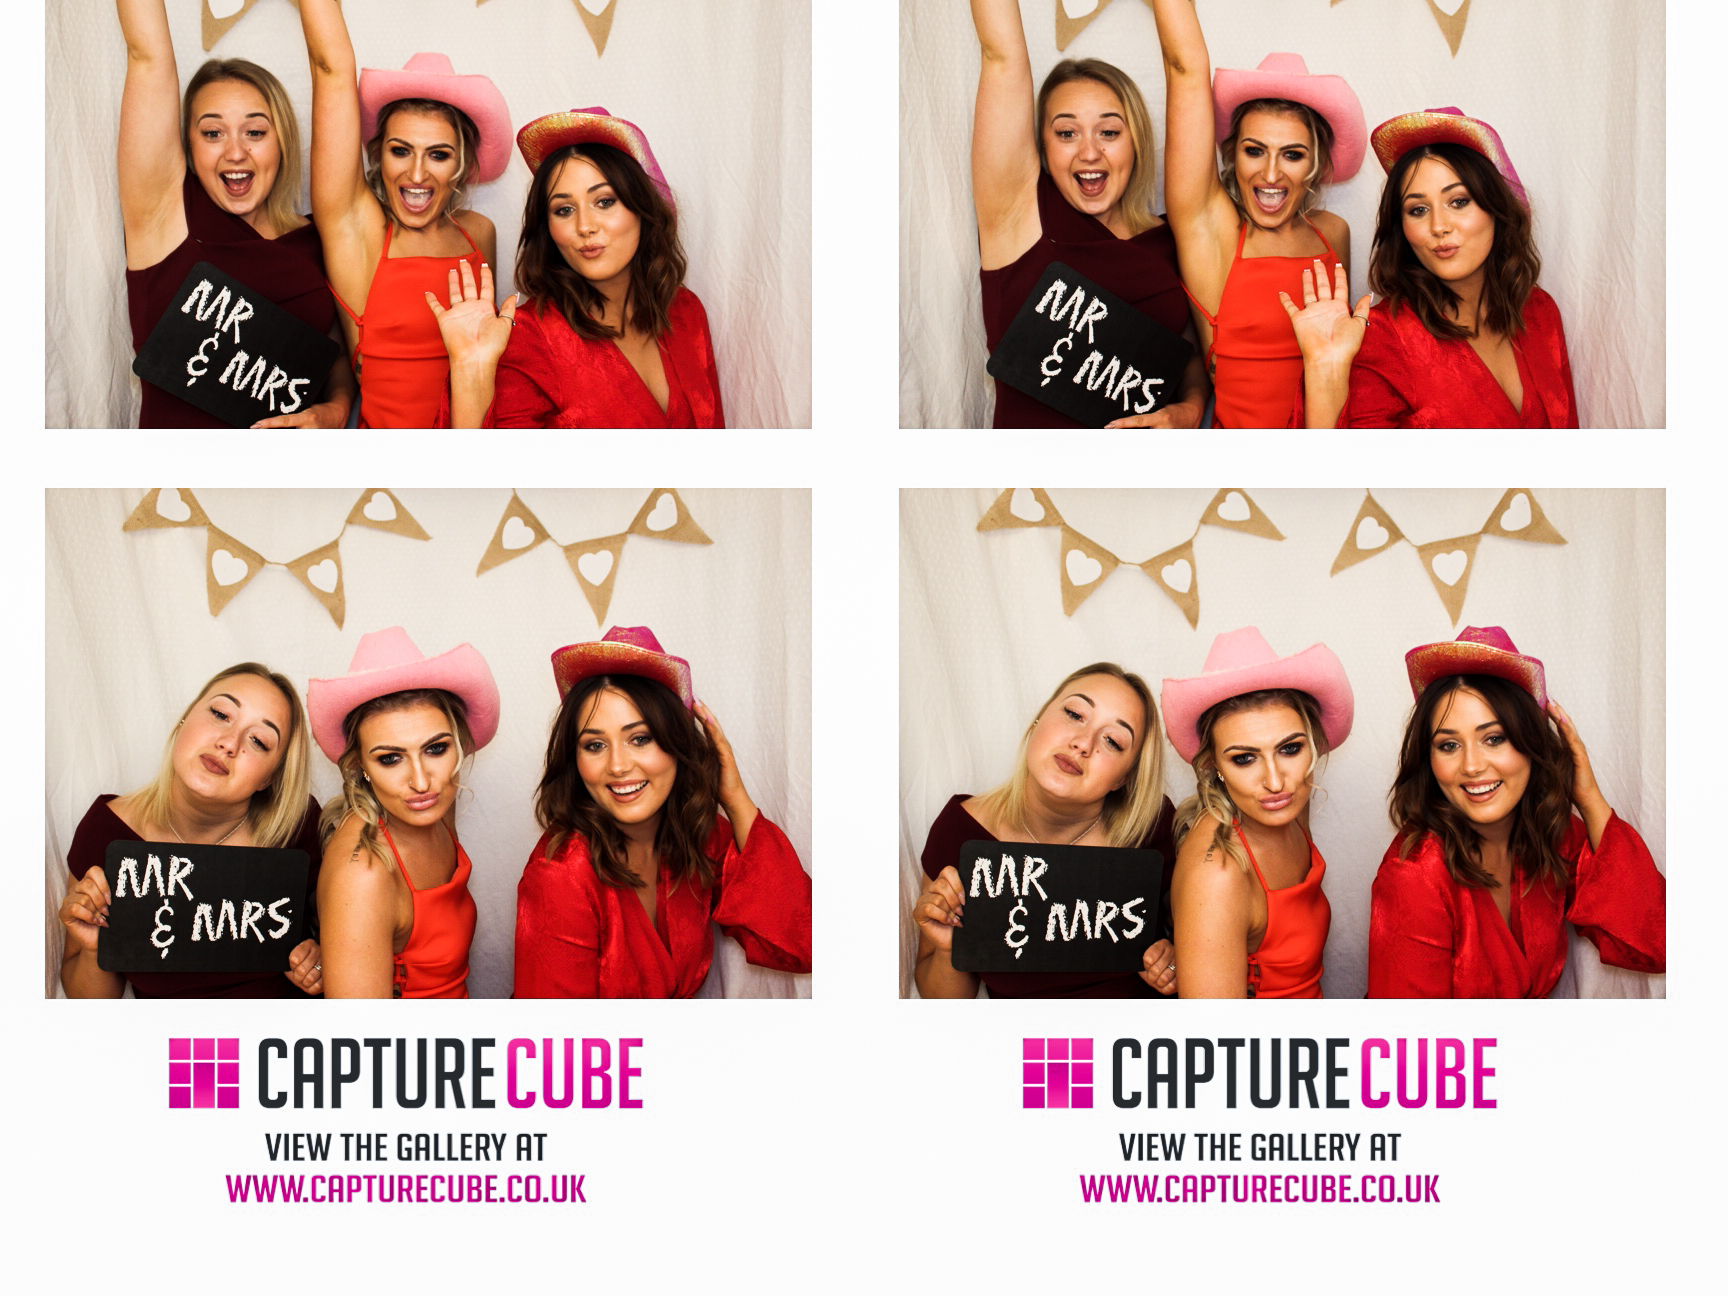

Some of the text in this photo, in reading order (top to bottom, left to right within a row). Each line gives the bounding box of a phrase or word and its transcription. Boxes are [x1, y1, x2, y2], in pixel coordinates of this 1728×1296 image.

[181, 279, 254, 344] MR
[1035, 279, 1108, 344] MR
[186, 331, 219, 386] &
[1040, 331, 1073, 386] &
[115, 854, 195, 901] MR
[969, 854, 1049, 901] MR
[150, 899, 176, 959] &
[1004, 899, 1030, 959] &
